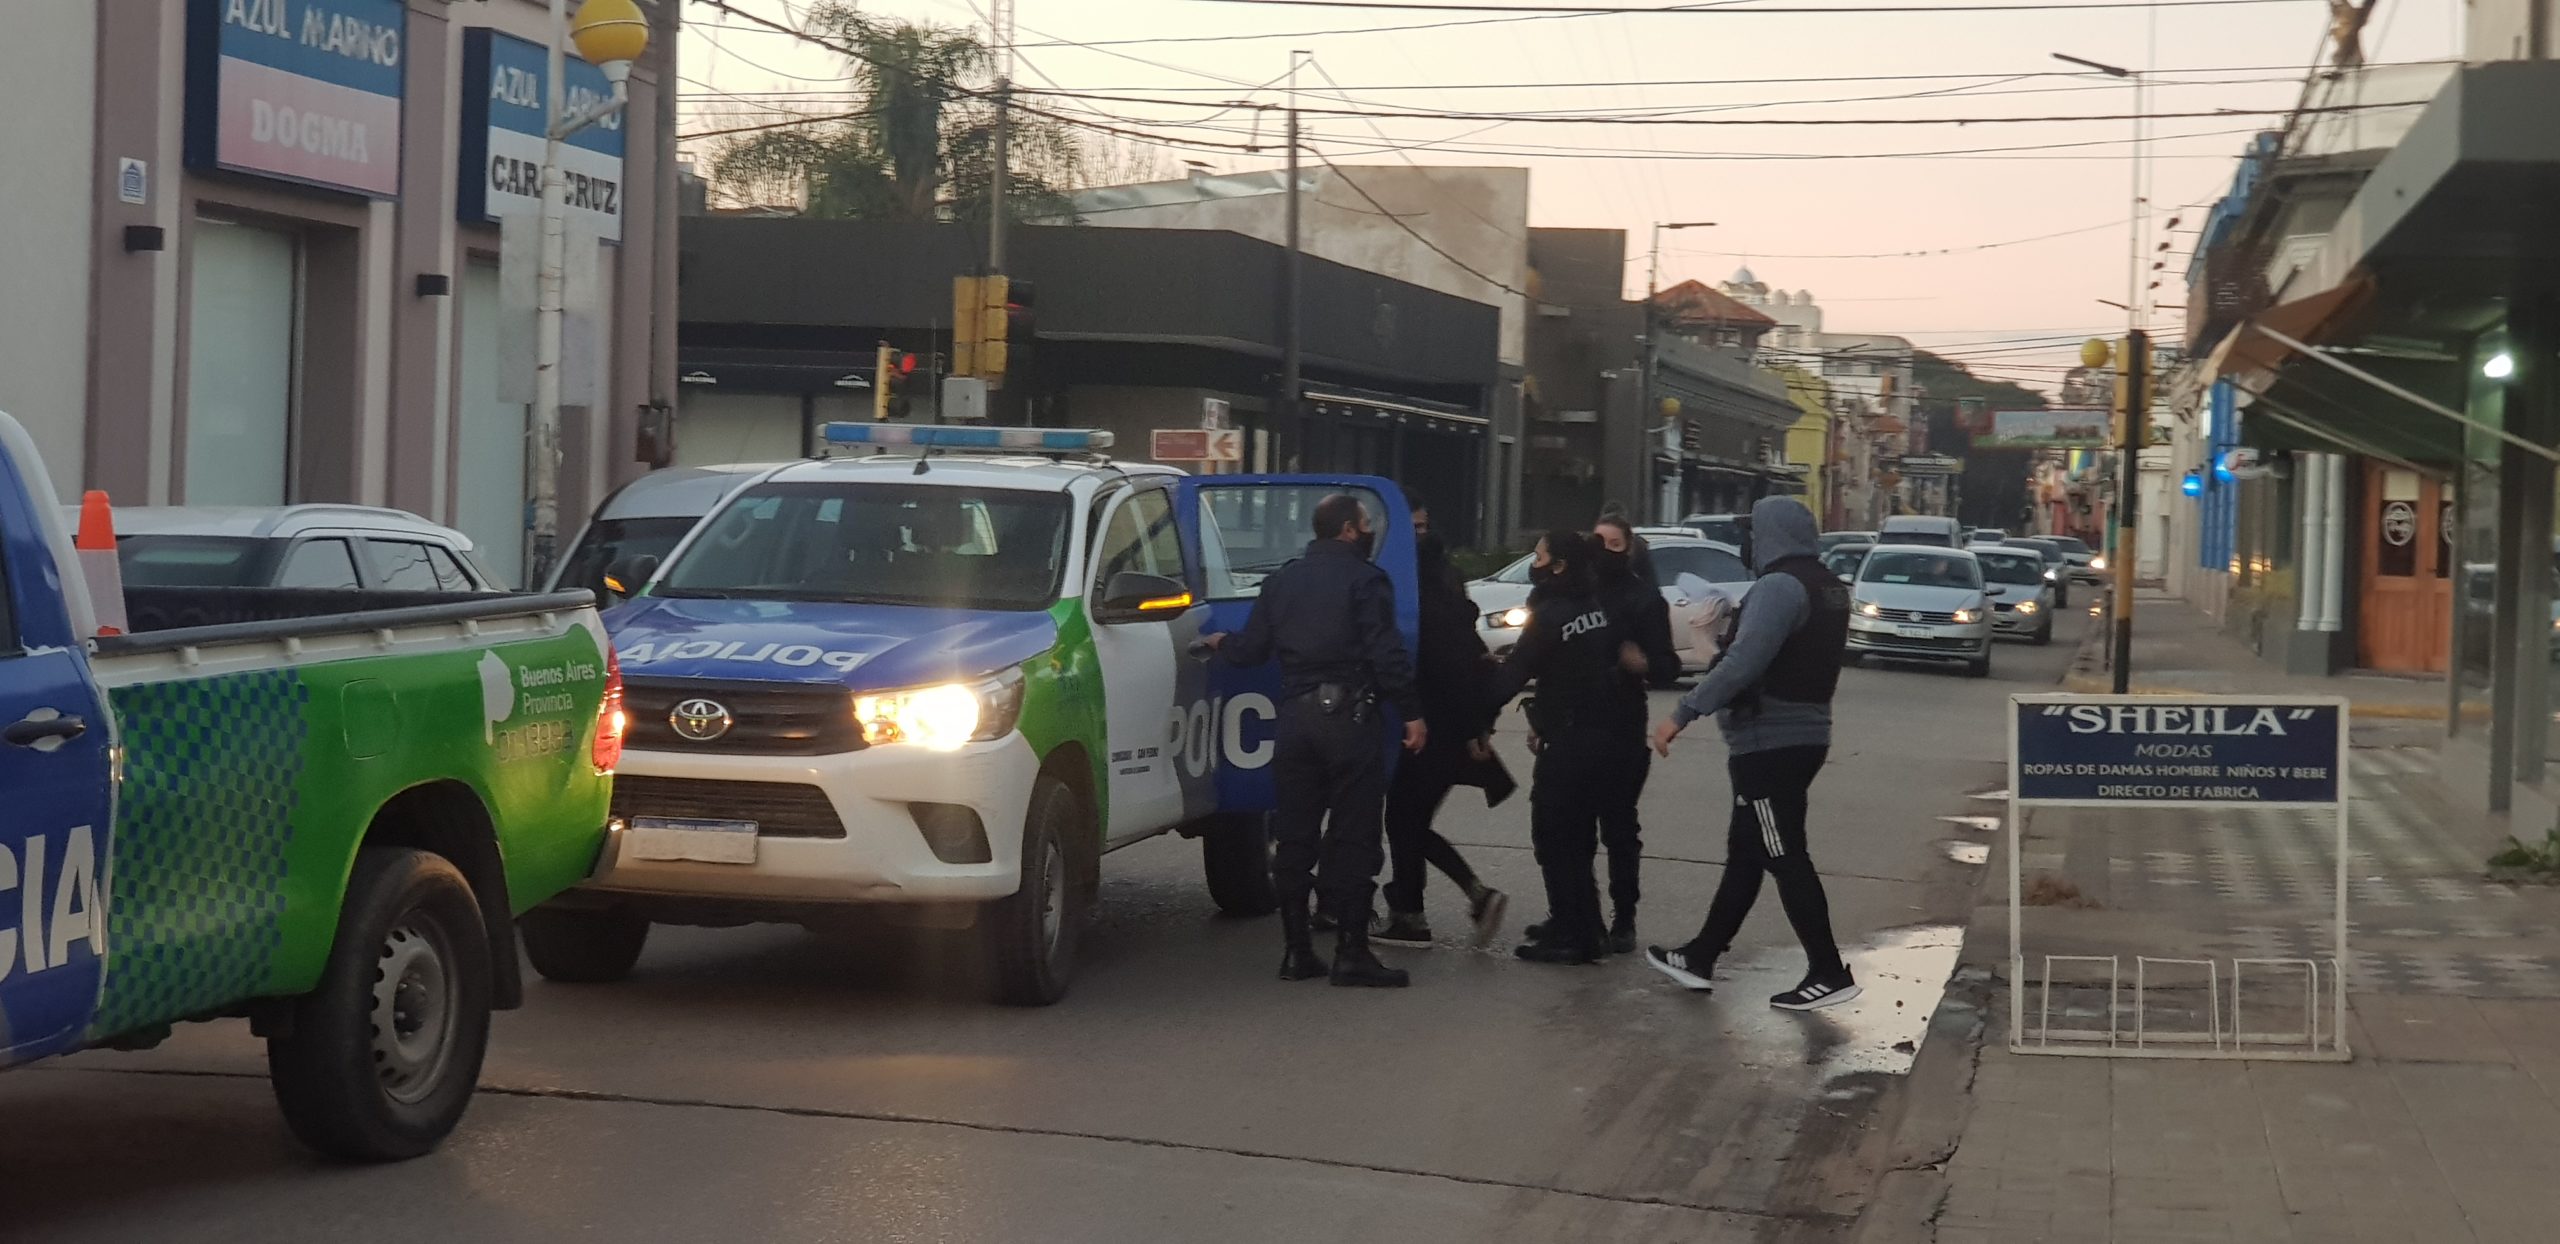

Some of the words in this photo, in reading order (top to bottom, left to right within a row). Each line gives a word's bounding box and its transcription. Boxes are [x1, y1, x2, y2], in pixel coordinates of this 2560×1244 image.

[225, 0, 291, 39] AZUL
[301, 4, 398, 67] MARINO
[491, 64, 540, 109] AZUL
[251, 98, 369, 164] DOGMA
[520, 664, 563, 688] Buenos
[565, 660, 596, 682] Aires
[523, 688, 573, 715] Provincia
[2042, 704, 2316, 735] "SHEILA"
[2134, 743, 2213, 758] MODAS
[2024, 763, 2073, 776] ROPAS
[2076, 763, 2096, 776] DE
[2100, 764, 2153, 777] DAMAS
[2157, 765, 2220, 778] HOMBRE
[2226, 763, 2276, 779] NIÑOS
[2279, 766, 2291, 779] Y
[2293, 767, 2327, 780] BEBE
[2098, 784, 2166, 798] DIRECTO
[2170, 785, 2190, 798] DE
[2194, 785, 2260, 799] FABRICA
